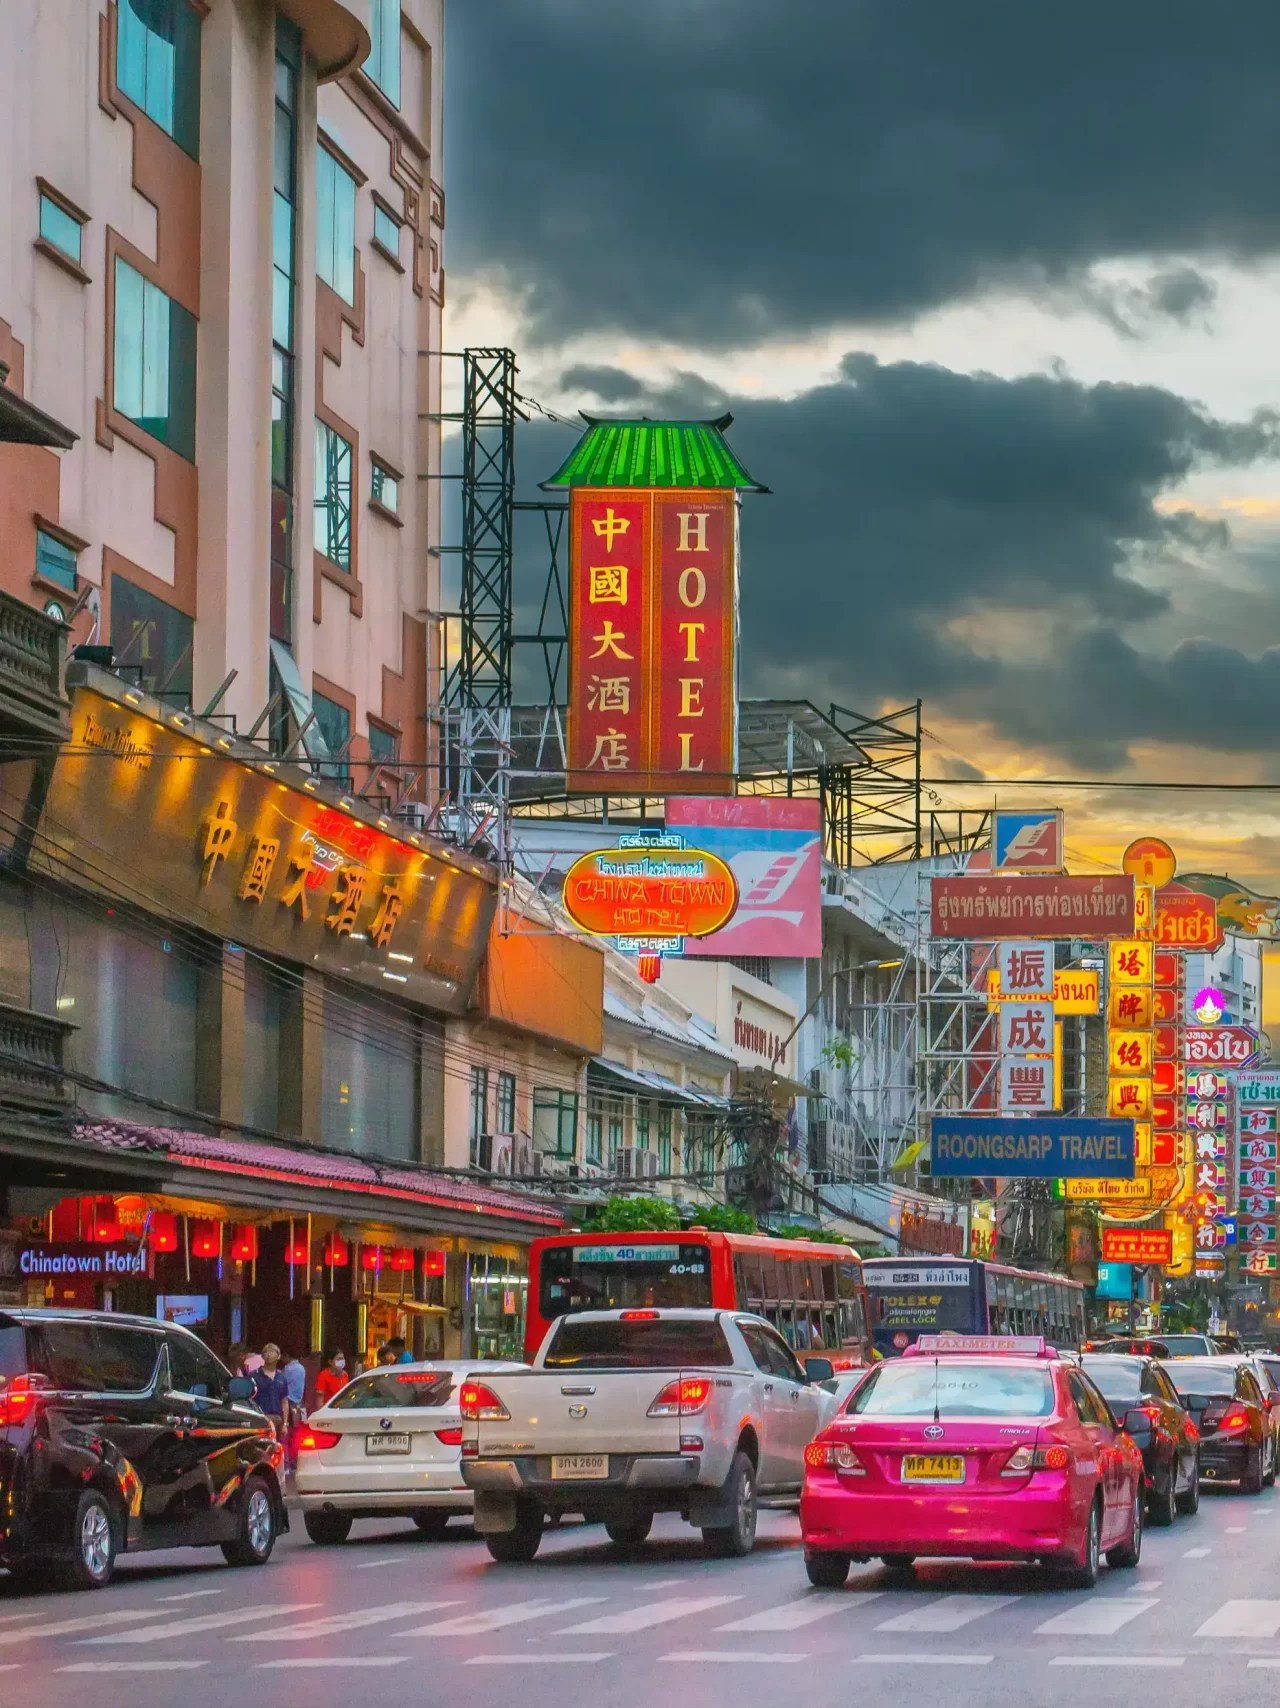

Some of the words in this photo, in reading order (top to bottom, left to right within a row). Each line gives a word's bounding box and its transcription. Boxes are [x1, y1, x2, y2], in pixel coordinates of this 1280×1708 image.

[586, 508, 634, 771] 中國大酒店
[676, 512, 709, 772] HOTEL
[575, 879, 647, 904] CHINA
[658, 880, 728, 905] TOWN
[937, 879, 1128, 932] รุ่งทรัพย์การท่องเที่ยว
[614, 908, 686, 929] HOTEL
[937, 1135, 1053, 1159] ROONGSARP
[1058, 1135, 1128, 1160] TRAVEL
[20, 1250, 101, 1273] Chinatown
[105, 1249, 146, 1273] Hotel
[617, 1249, 634, 1258] 40
[670, 1264, 704, 1274] 40-83
[887, 1295, 928, 1306] OLEX
[929, 1456, 959, 1470] 7413
